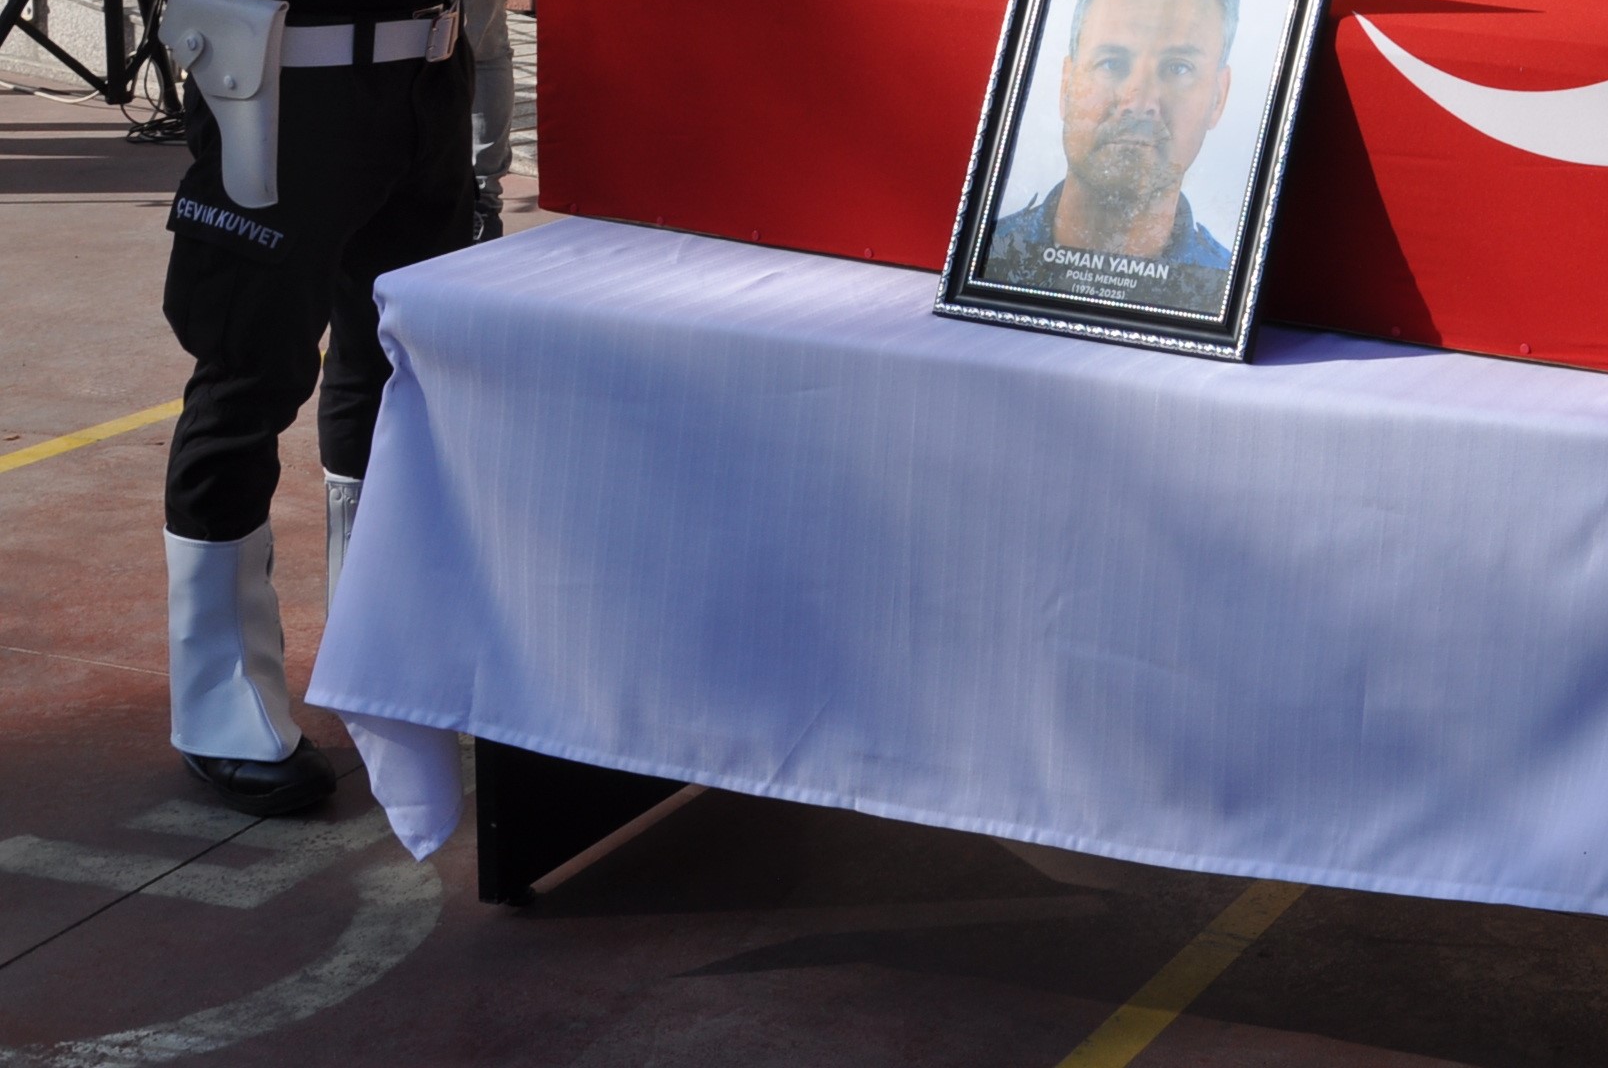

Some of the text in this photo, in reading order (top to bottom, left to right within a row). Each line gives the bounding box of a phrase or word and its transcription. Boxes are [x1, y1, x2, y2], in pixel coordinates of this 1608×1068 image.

[176, 197, 285, 249] ÇEVİK KUVVET
[1043, 247, 1170, 280] OSMAN YAMAN
[1065, 268, 1138, 290] POLİS MEMURU
[1071, 283, 1126, 301] (1976-2025)
